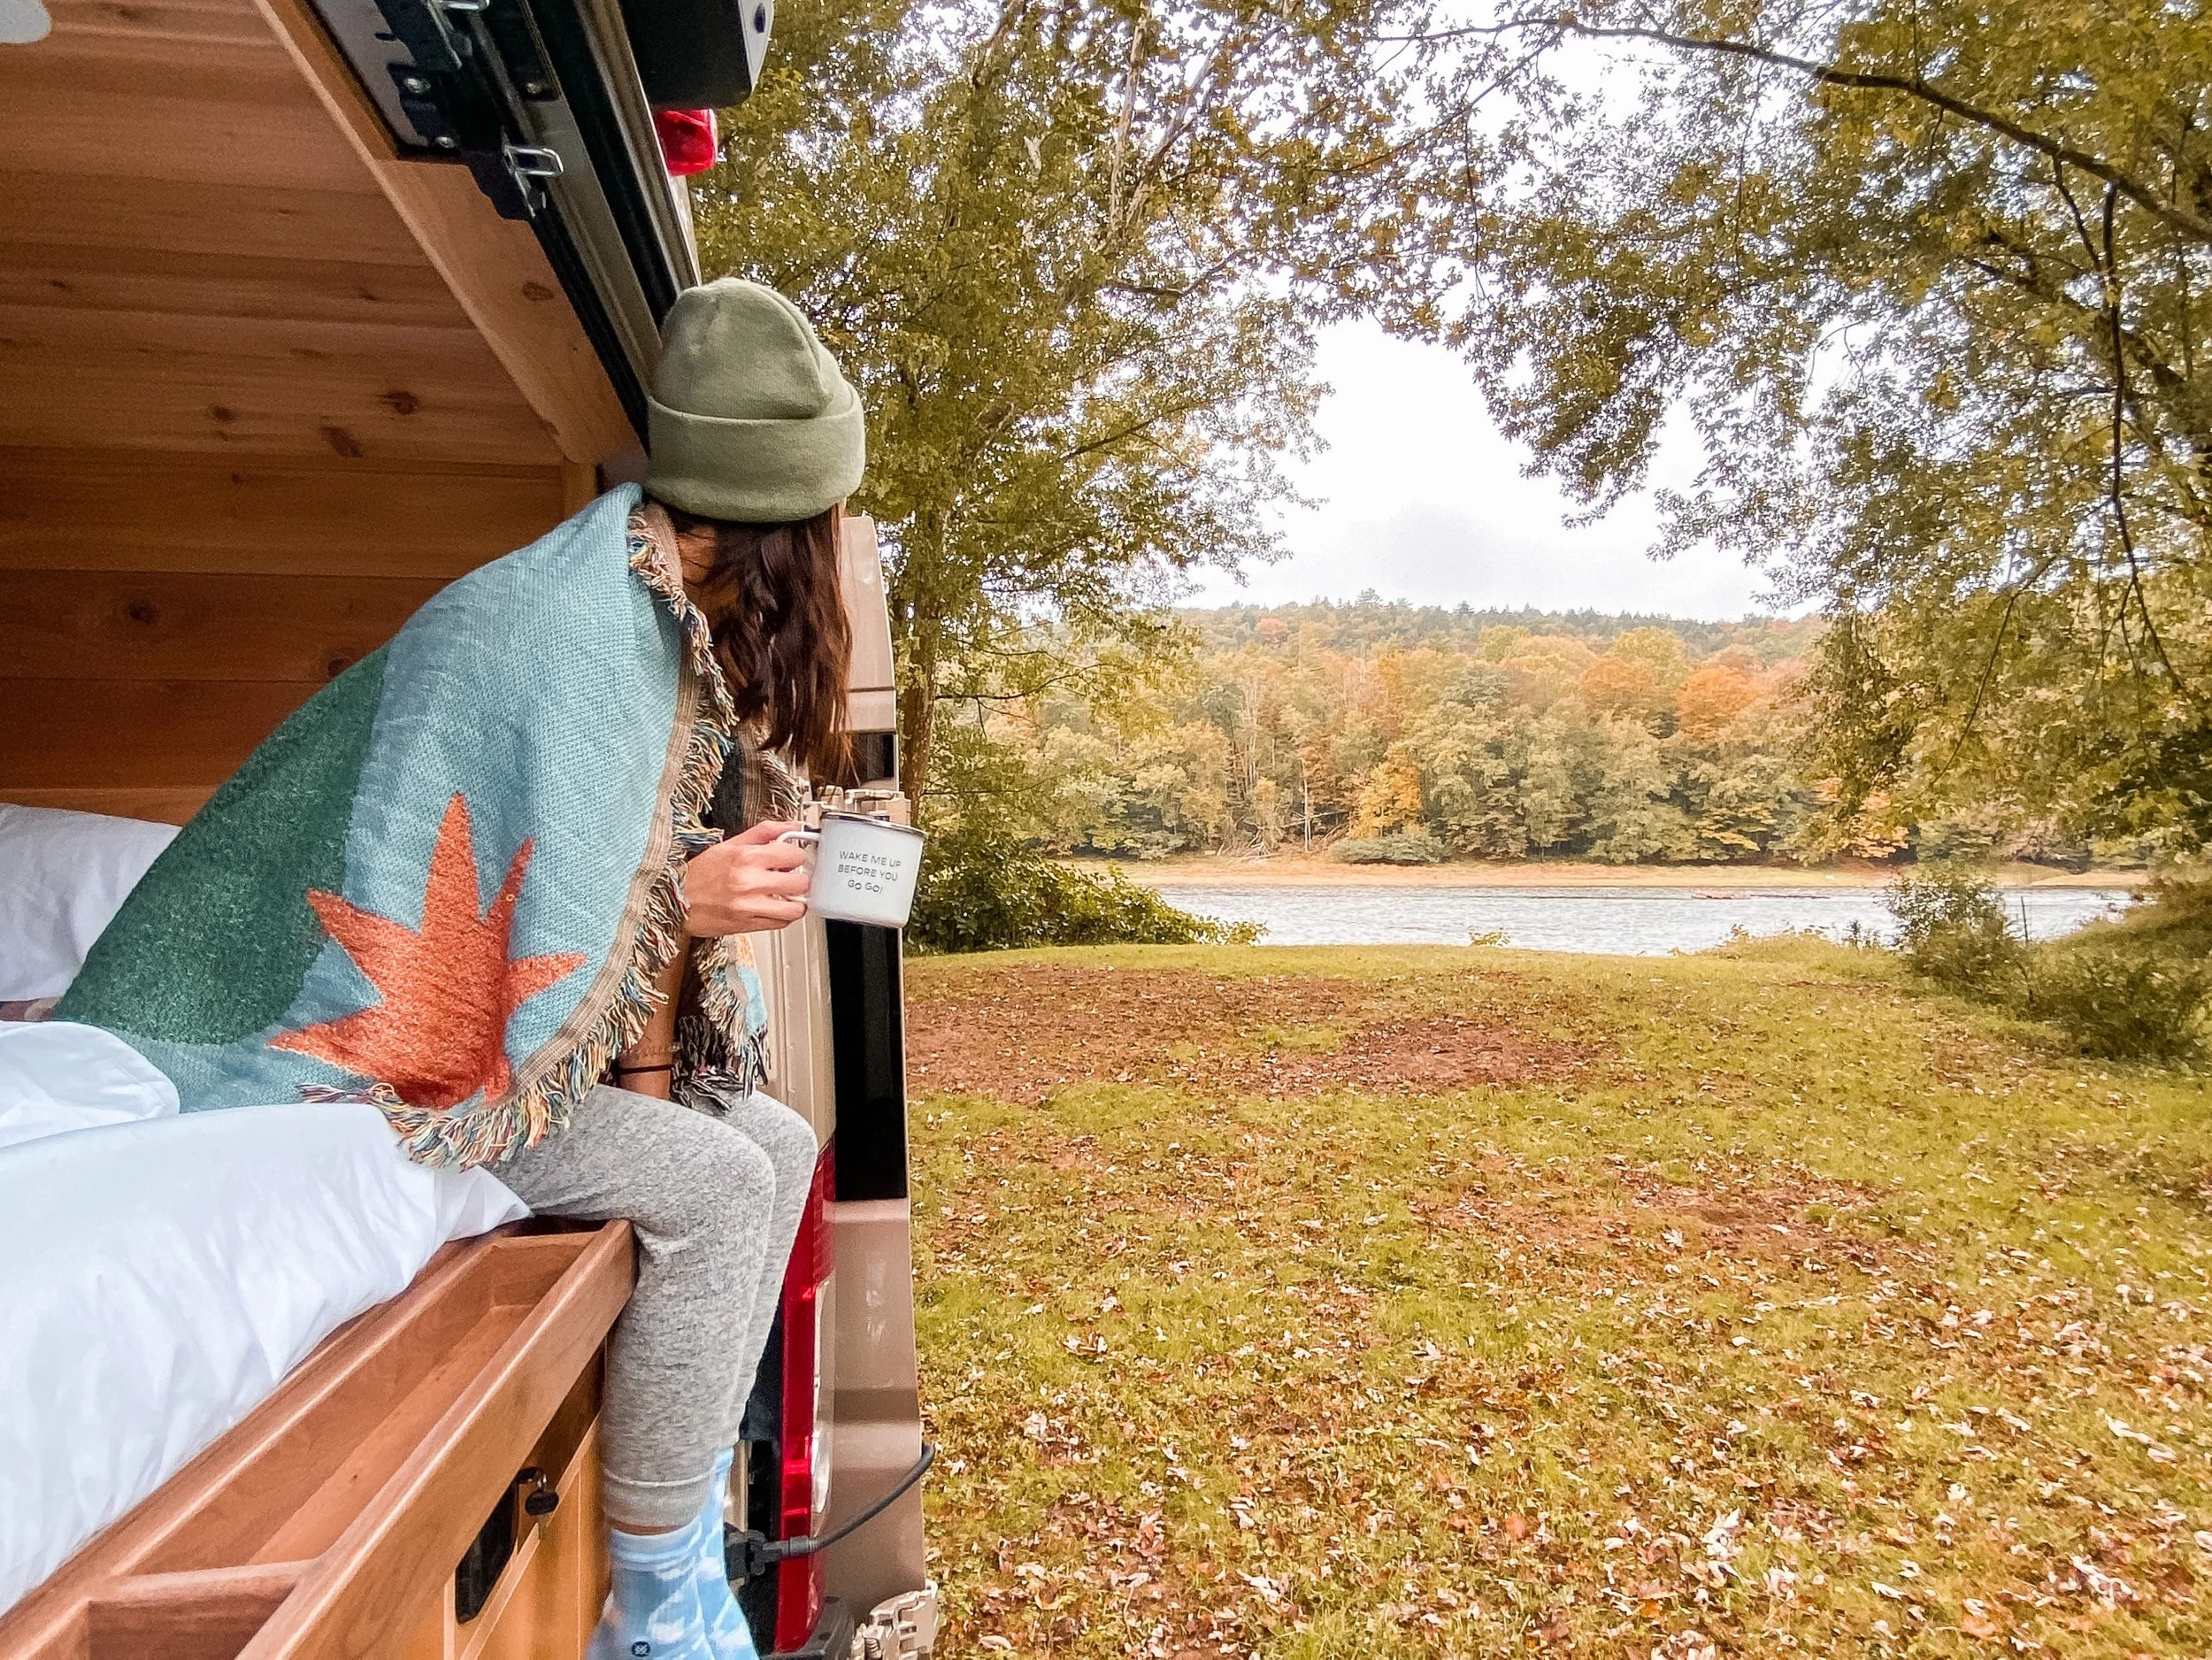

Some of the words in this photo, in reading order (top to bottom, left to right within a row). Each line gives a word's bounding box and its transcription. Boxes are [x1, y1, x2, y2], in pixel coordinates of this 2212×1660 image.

[839, 850, 868, 862] WAKE
[871, 855, 887, 865] ME
[889, 858, 902, 867] UP
[838, 864, 877, 878] BEFORE
[879, 870, 898, 881] YOU
[848, 880, 862, 890] GO
[864, 882, 884, 895] GO!
